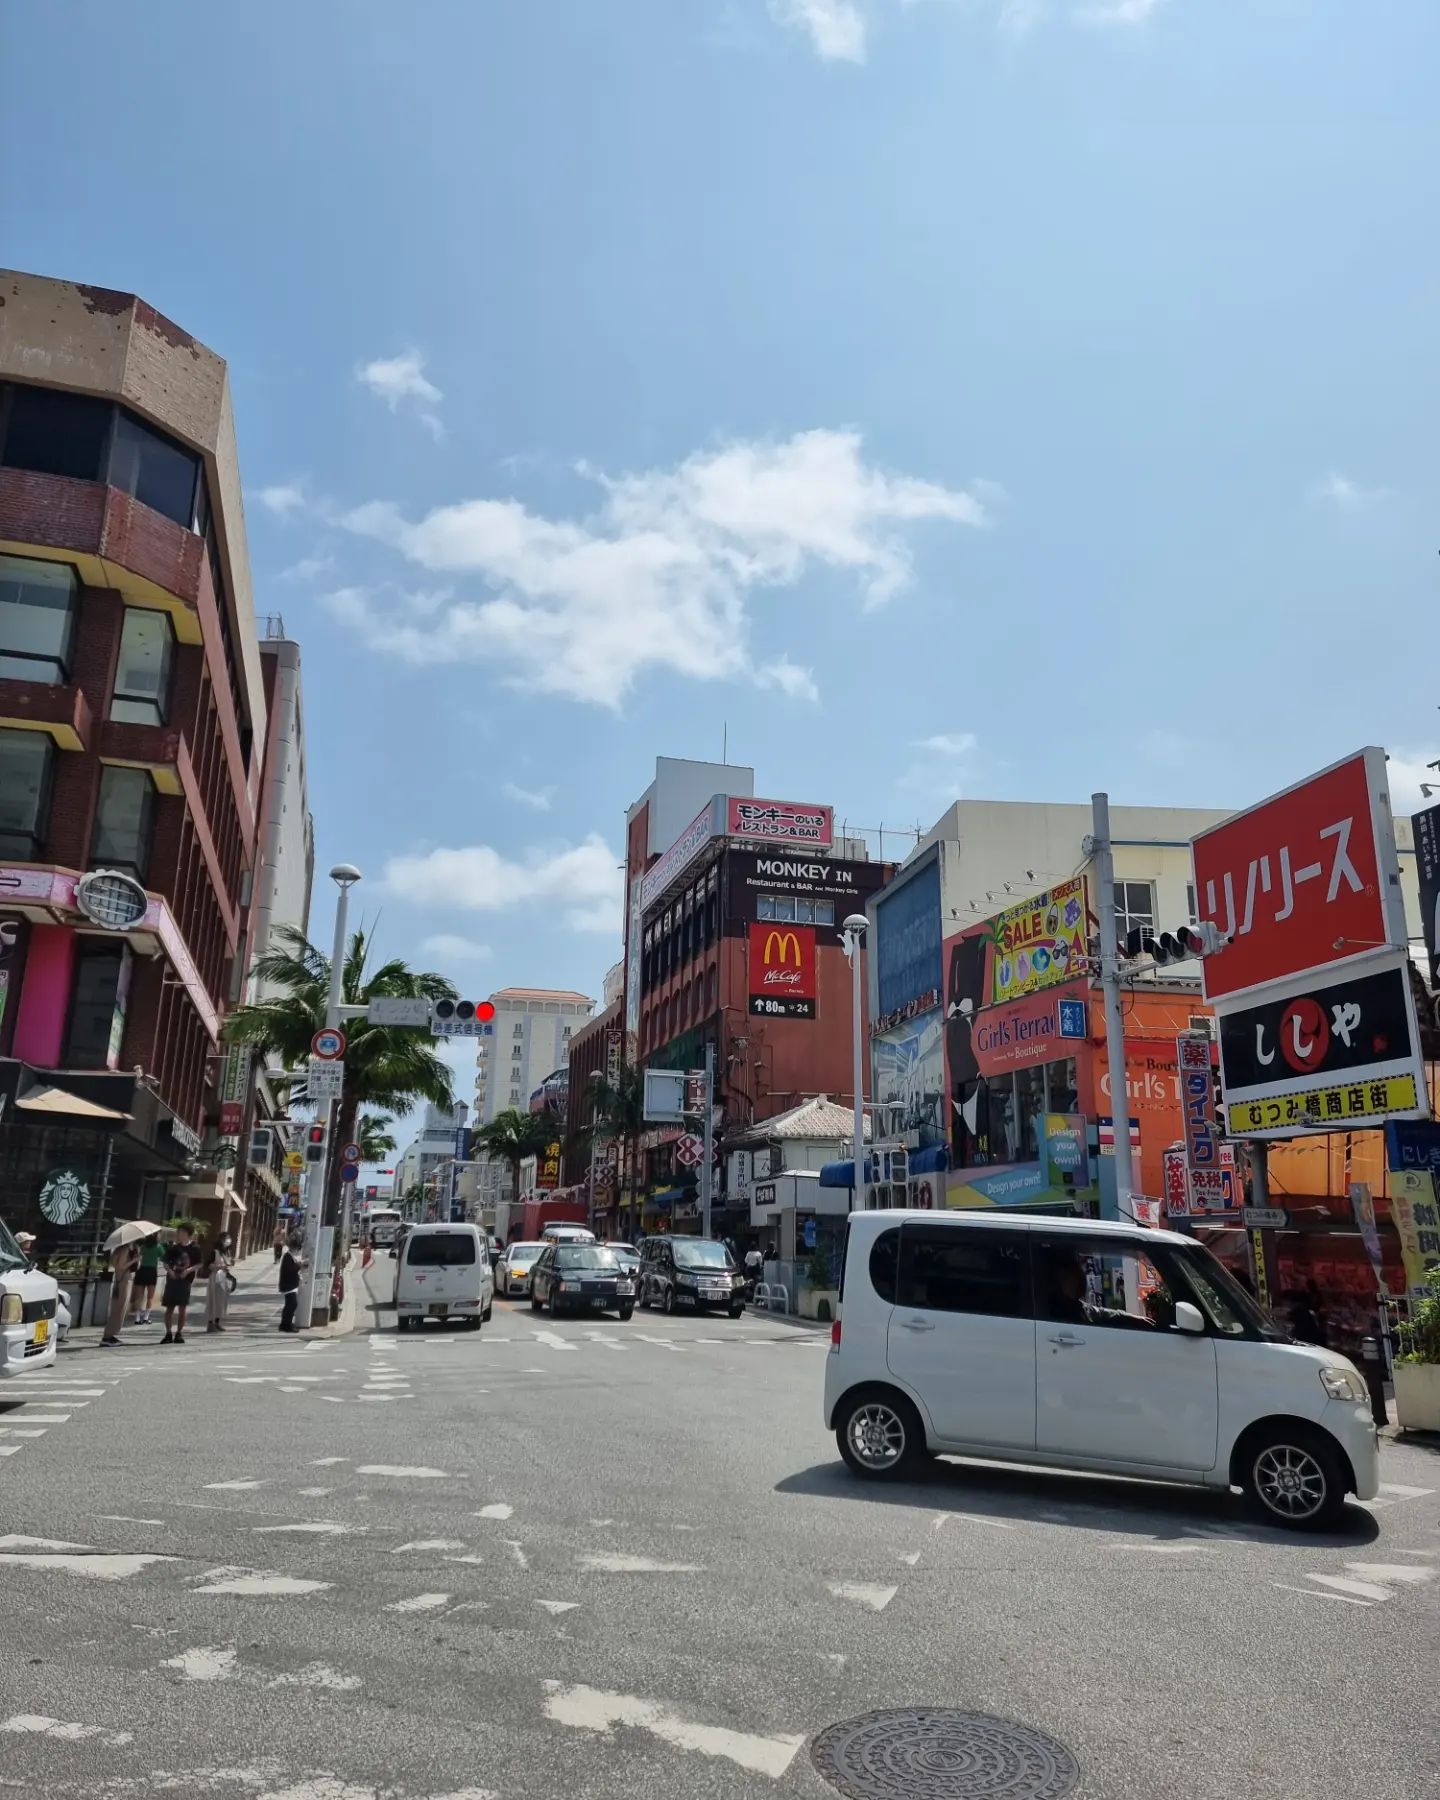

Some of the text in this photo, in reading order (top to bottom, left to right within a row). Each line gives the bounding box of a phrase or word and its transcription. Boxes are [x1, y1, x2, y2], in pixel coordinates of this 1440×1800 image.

[737, 804, 824, 826] モンキーのいる
[742, 821, 820, 838] レストラン&BAR
[756, 859, 853, 883] MONKEY IN
[746, 877, 790, 890] Restaurant
[796, 882, 813, 891] BAR
[1003, 912, 1042, 949] SALE
[765, 1000, 809, 1013] 80m 24
[433, 1022, 493, 1036] 時差式信号機
[977, 1021, 1010, 1052] Girl's
[1011, 1016, 1055, 1041] Terra
[1256, 1002, 1362, 1067] ししや
[1015, 1043, 1048, 1059] Boutique
[1249, 1086, 1389, 1125] むつみ橋商店街
[1187, 1071, 1216, 1164] ダイコク
[1049, 1127, 1081, 1137] Design
[1056, 1142, 1076, 1151] your
[544, 1142, 560, 1175] 焼肉
[1054, 1154, 1081, 1165] own!!
[1220, 1152, 1232, 1161] ree
[987, 1182, 1009, 1194] Design
[1009, 1179, 1023, 1192] your
[1191, 1170, 1222, 1188] 免税
